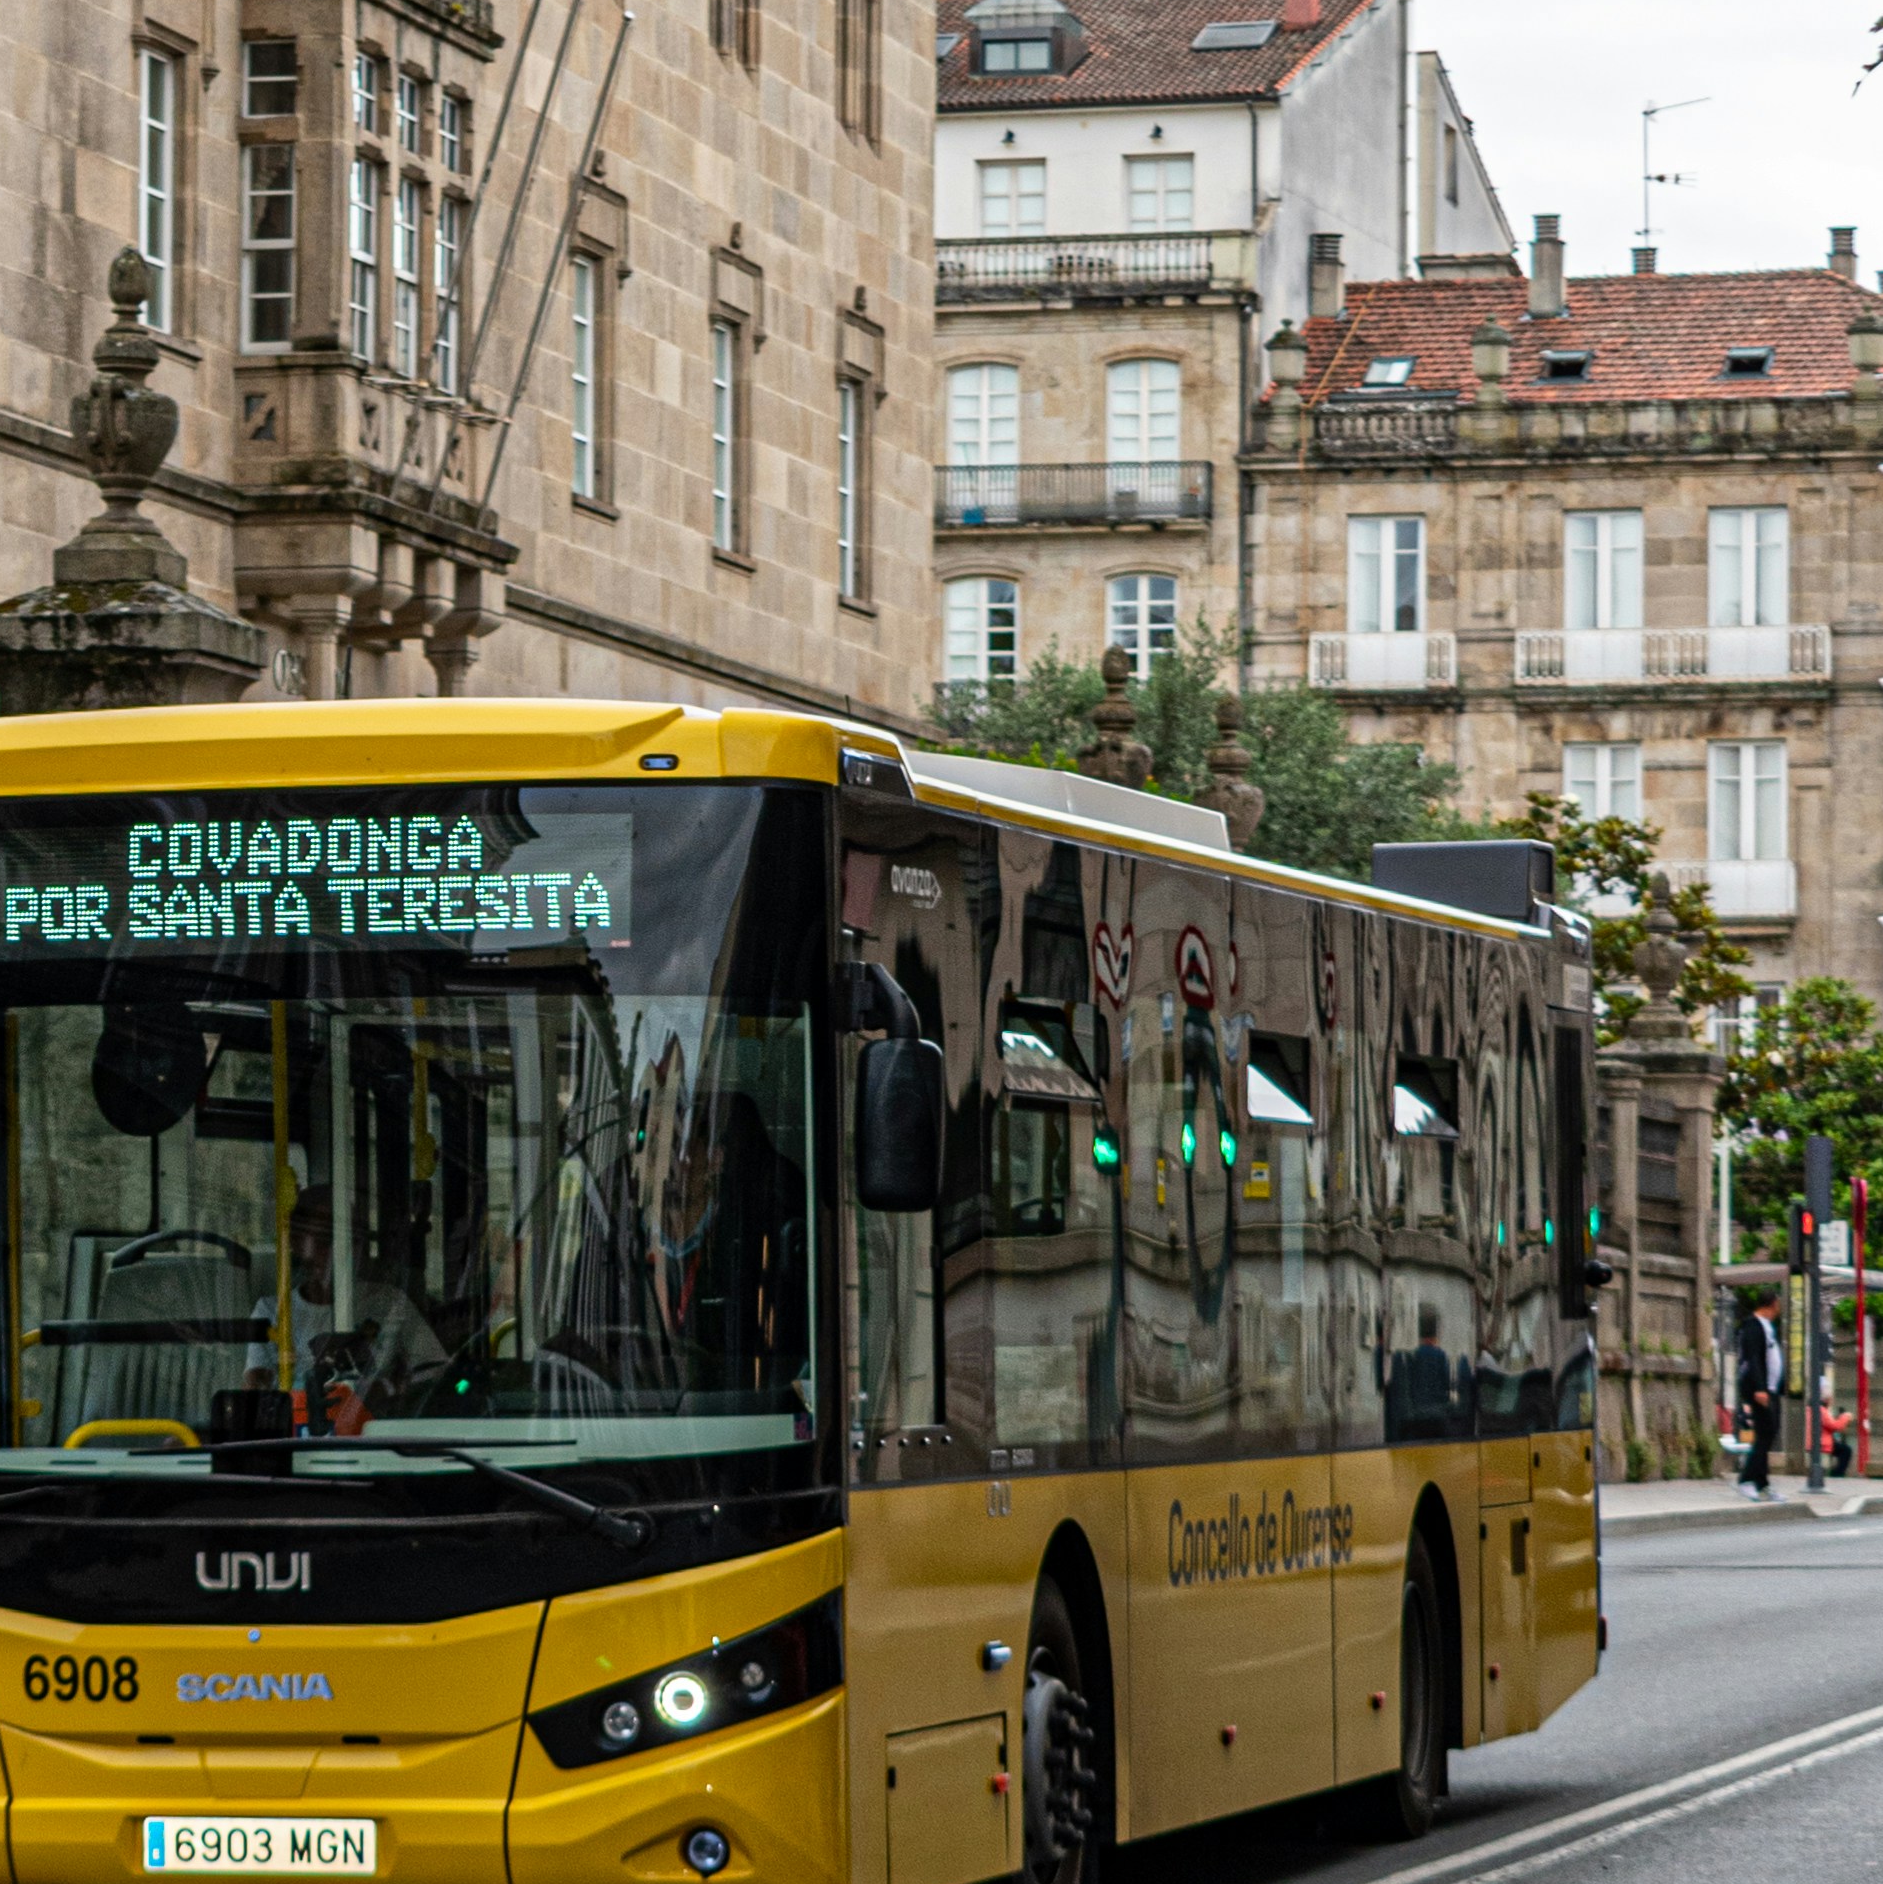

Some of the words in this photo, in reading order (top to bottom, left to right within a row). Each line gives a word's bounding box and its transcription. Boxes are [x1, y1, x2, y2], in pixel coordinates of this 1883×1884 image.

[127, 815, 483, 877] COVADONGA
[5, 885, 112, 943] POR
[128, 880, 311, 939] SANTA
[326, 872, 611, 934] TERESITA
[1168, 1492, 1250, 1587] Concello
[1255, 1490, 1276, 1576] de
[1282, 1489, 1352, 1570] Ourense
[22, 1653, 140, 1703] 6908
[176, 1672, 333, 1702] SCANIA
[175, 1827, 273, 1863] 6903
[290, 1828, 365, 1864] MGN
